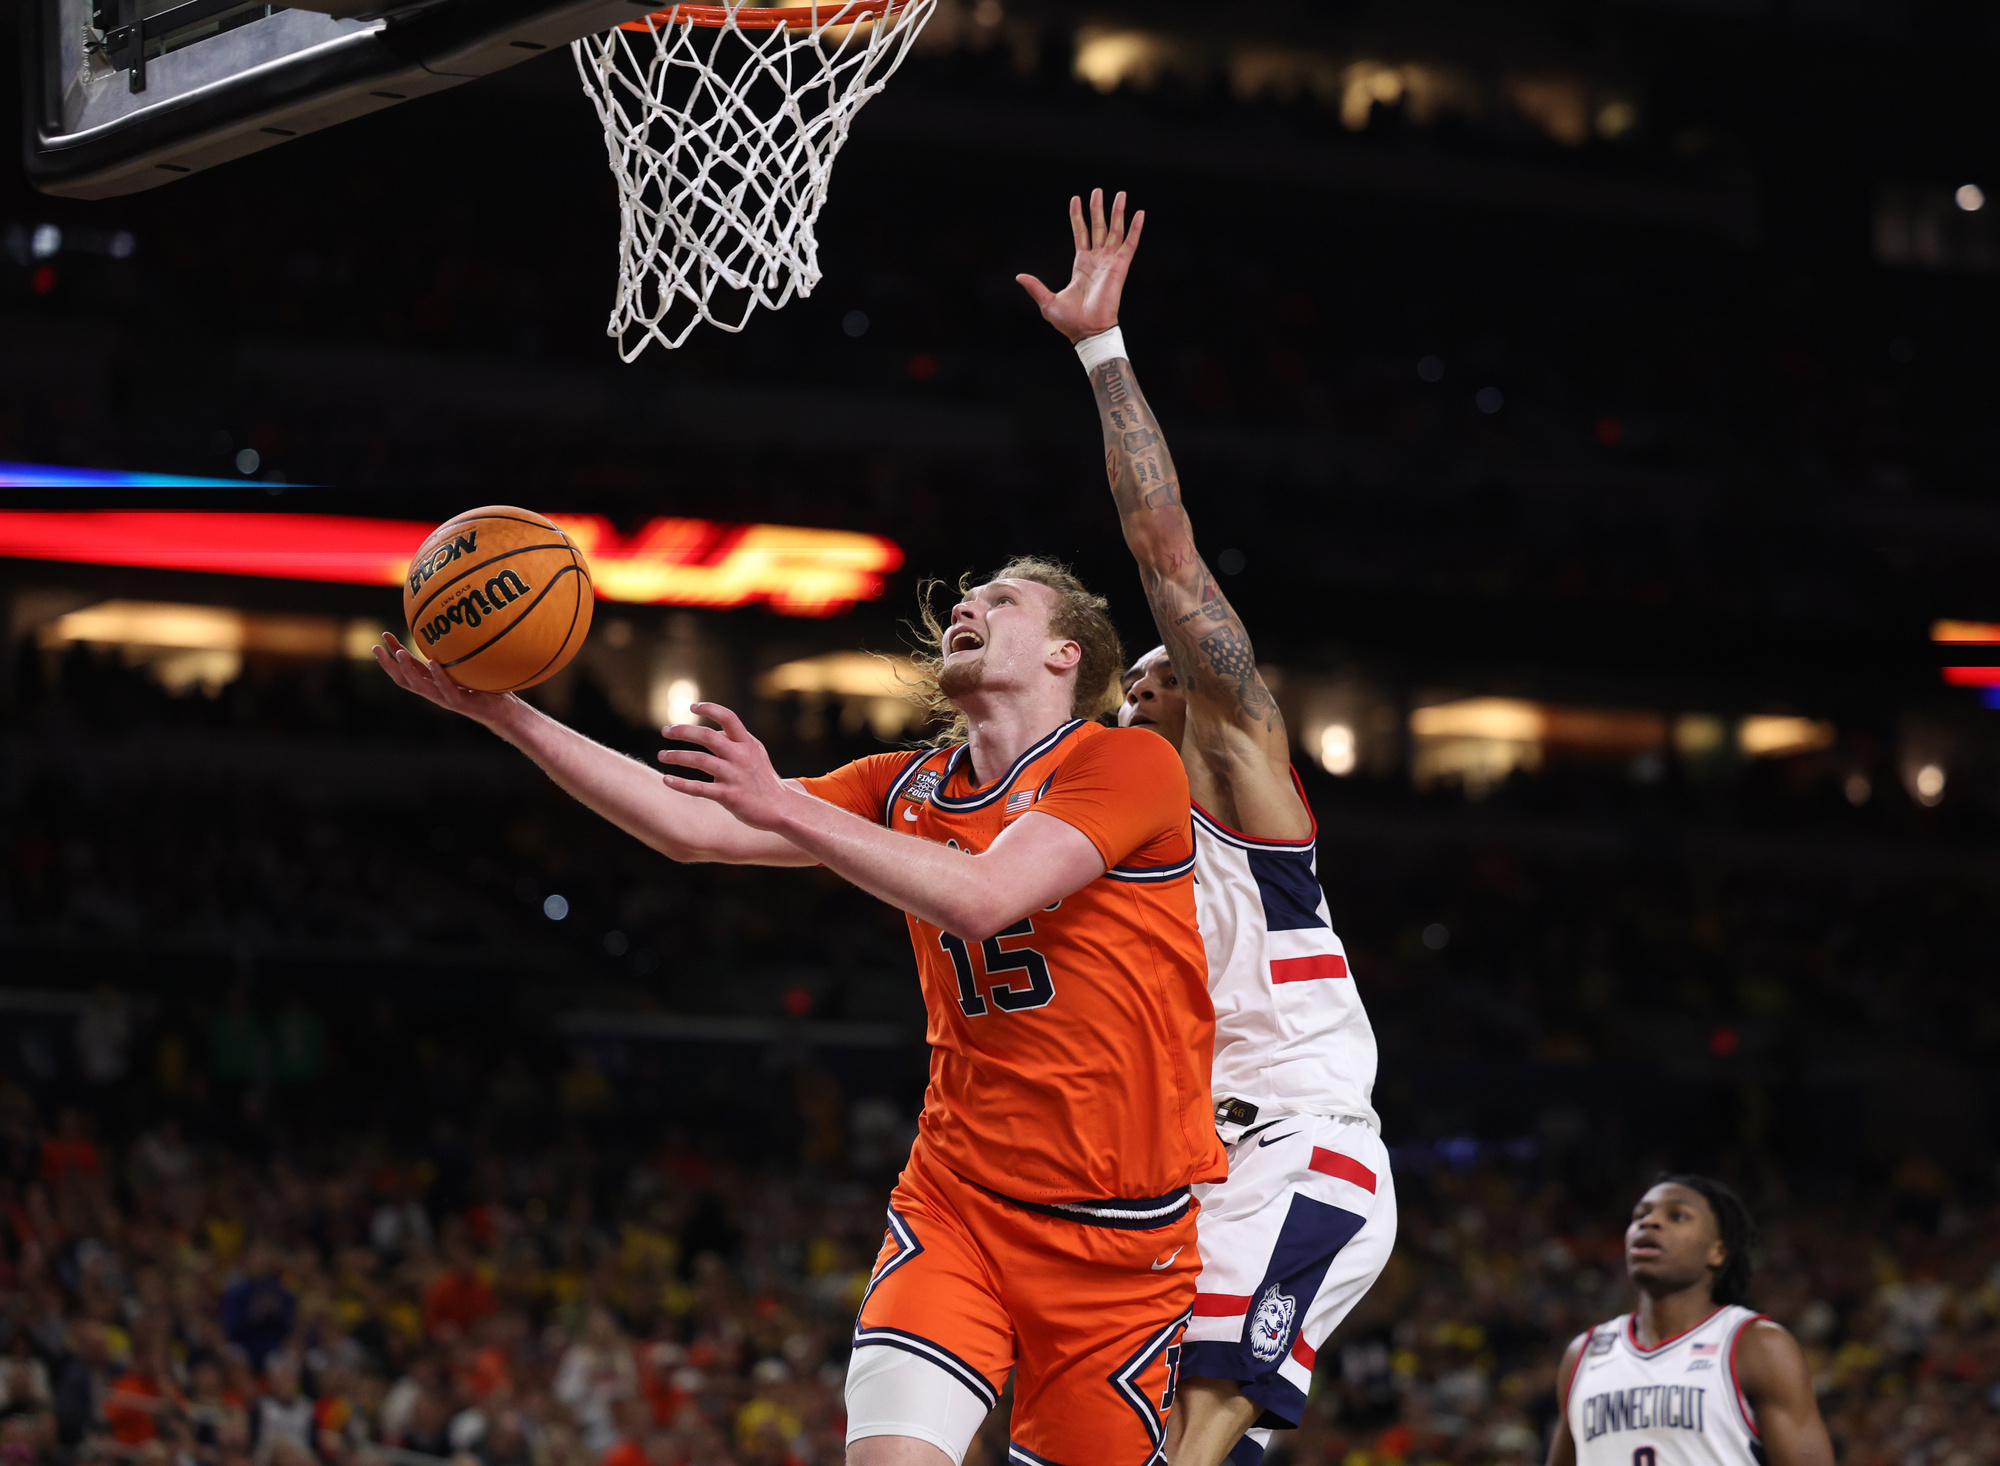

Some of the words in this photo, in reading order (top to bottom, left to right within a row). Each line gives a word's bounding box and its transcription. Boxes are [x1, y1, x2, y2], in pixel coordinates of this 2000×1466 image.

[1110, 410, 1127, 430] WOOD
[409, 530, 478, 596] NCAA
[420, 568, 532, 646] Wilson
[441, 595, 455, 608] NXT
[916, 773, 942, 787] FINAL
[907, 786, 931, 799] FOUR
[938, 917, 1056, 1017] 15
[1231, 1106, 1246, 1118] 46
[1583, 1384, 1705, 1442] CONNECTICUT
